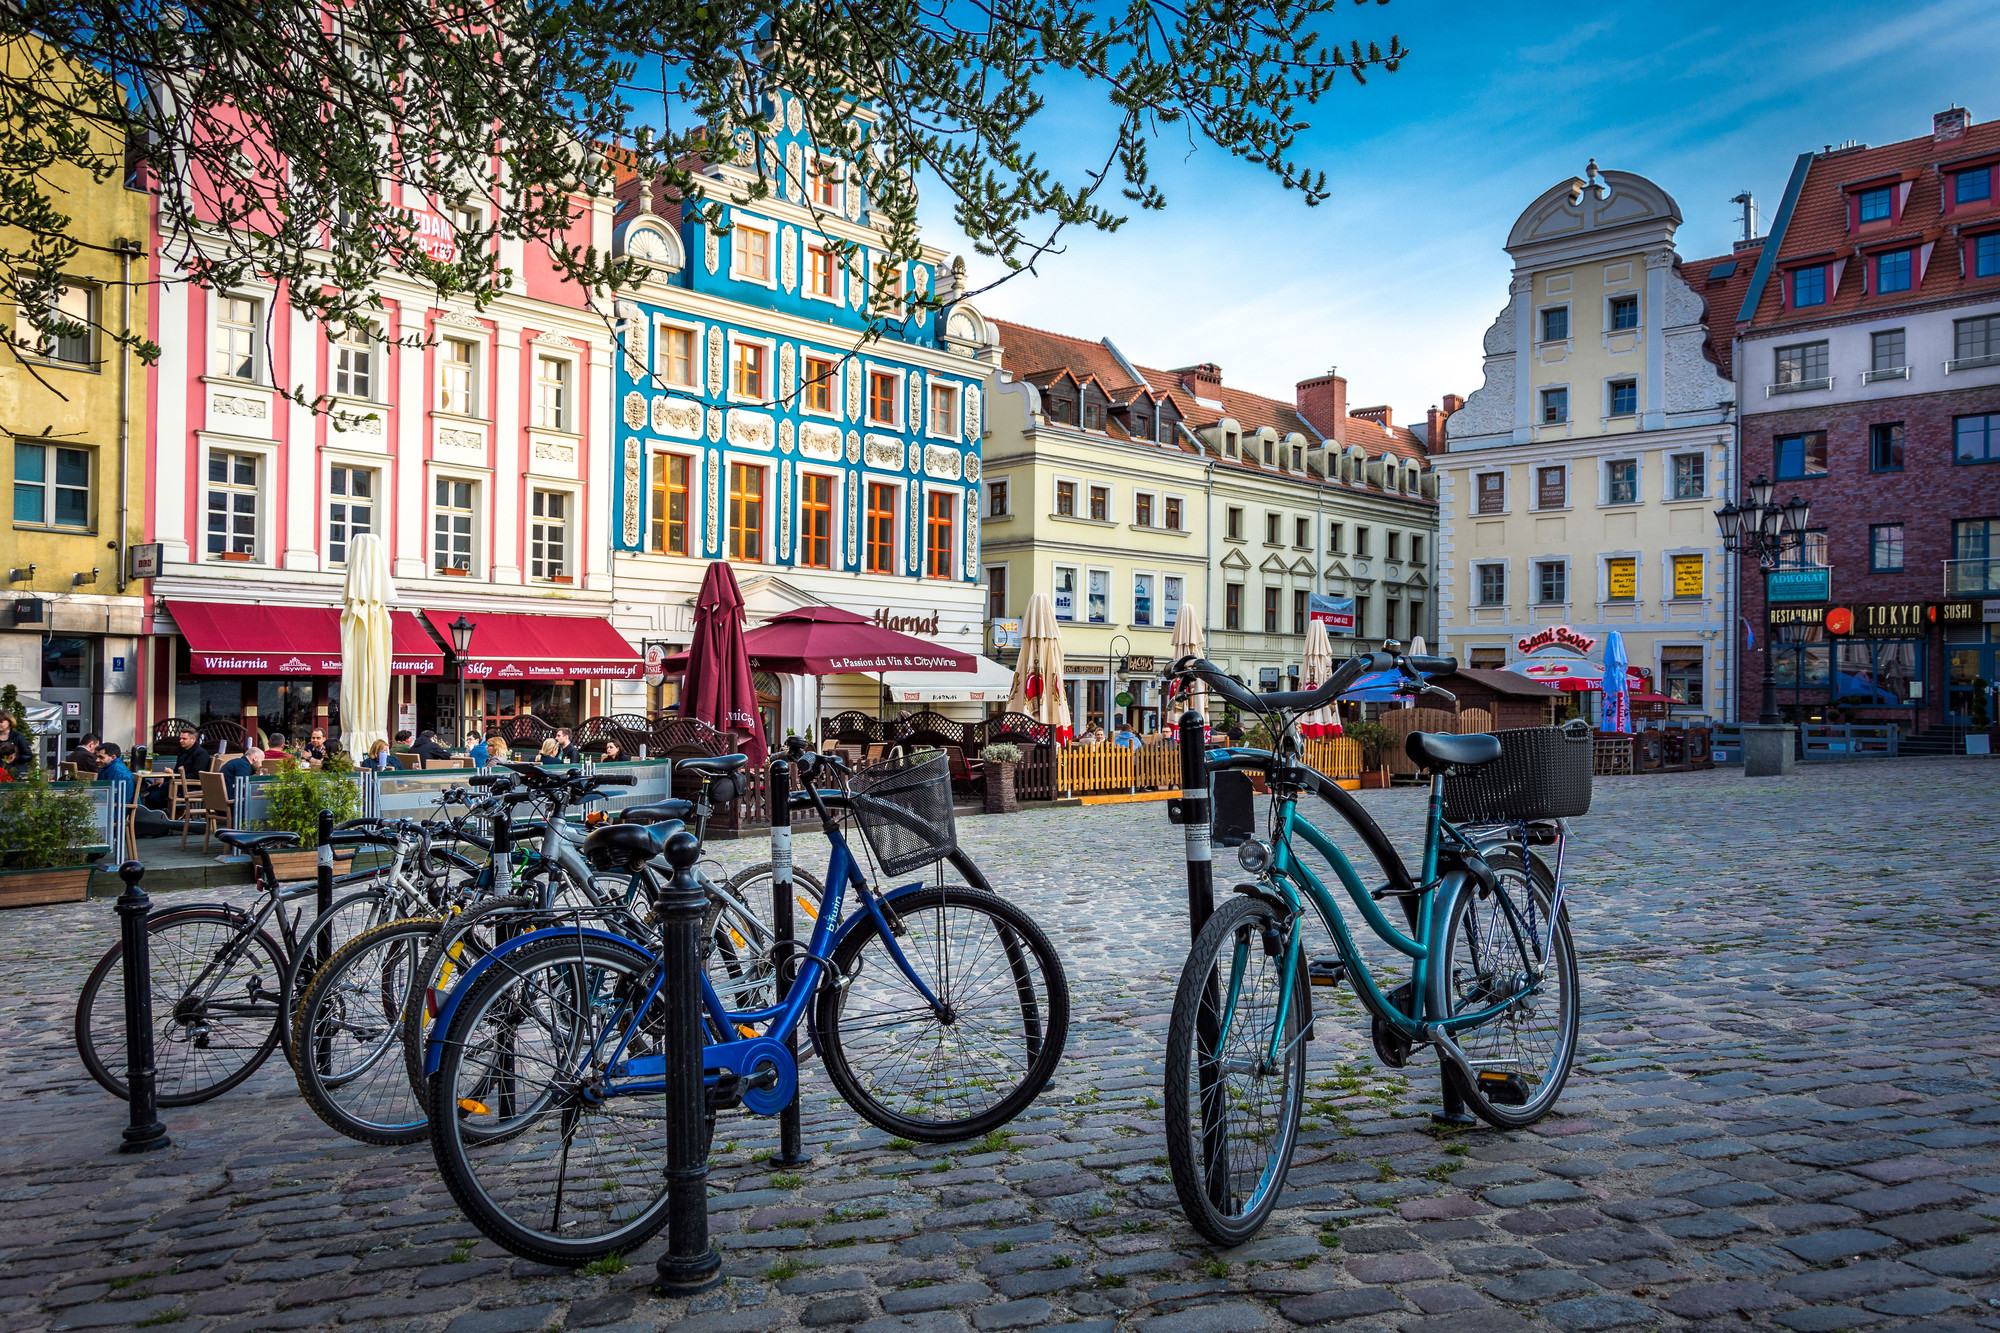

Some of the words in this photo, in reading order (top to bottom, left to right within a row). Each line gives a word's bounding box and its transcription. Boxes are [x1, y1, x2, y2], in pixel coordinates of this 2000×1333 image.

[1771, 574, 1825, 584] ADWOKAT
[1770, 608, 1823, 623] RESTAURANT
[1867, 605, 1920, 625] TOKYO
[1944, 604, 1972, 619] SUSHI
[1518, 627, 1555, 653] Sami
[1556, 627, 1594, 653] Swoi
[116, 658, 122, 667] 9
[204, 657, 268, 669] Winiarnia
[391, 660, 434, 674] tauracja
[645, 664, 662, 674] TYSKIE
[830, 658, 842, 668] La
[843, 657, 874, 668] Passion
[875, 656, 886, 666] du
[887, 656, 903, 666] Vin
[904, 656, 913, 666] &
[914, 656, 957, 668] CityWine
[467, 663, 493, 678] Sklep
[569, 664, 638, 679] www.winnica.pl
